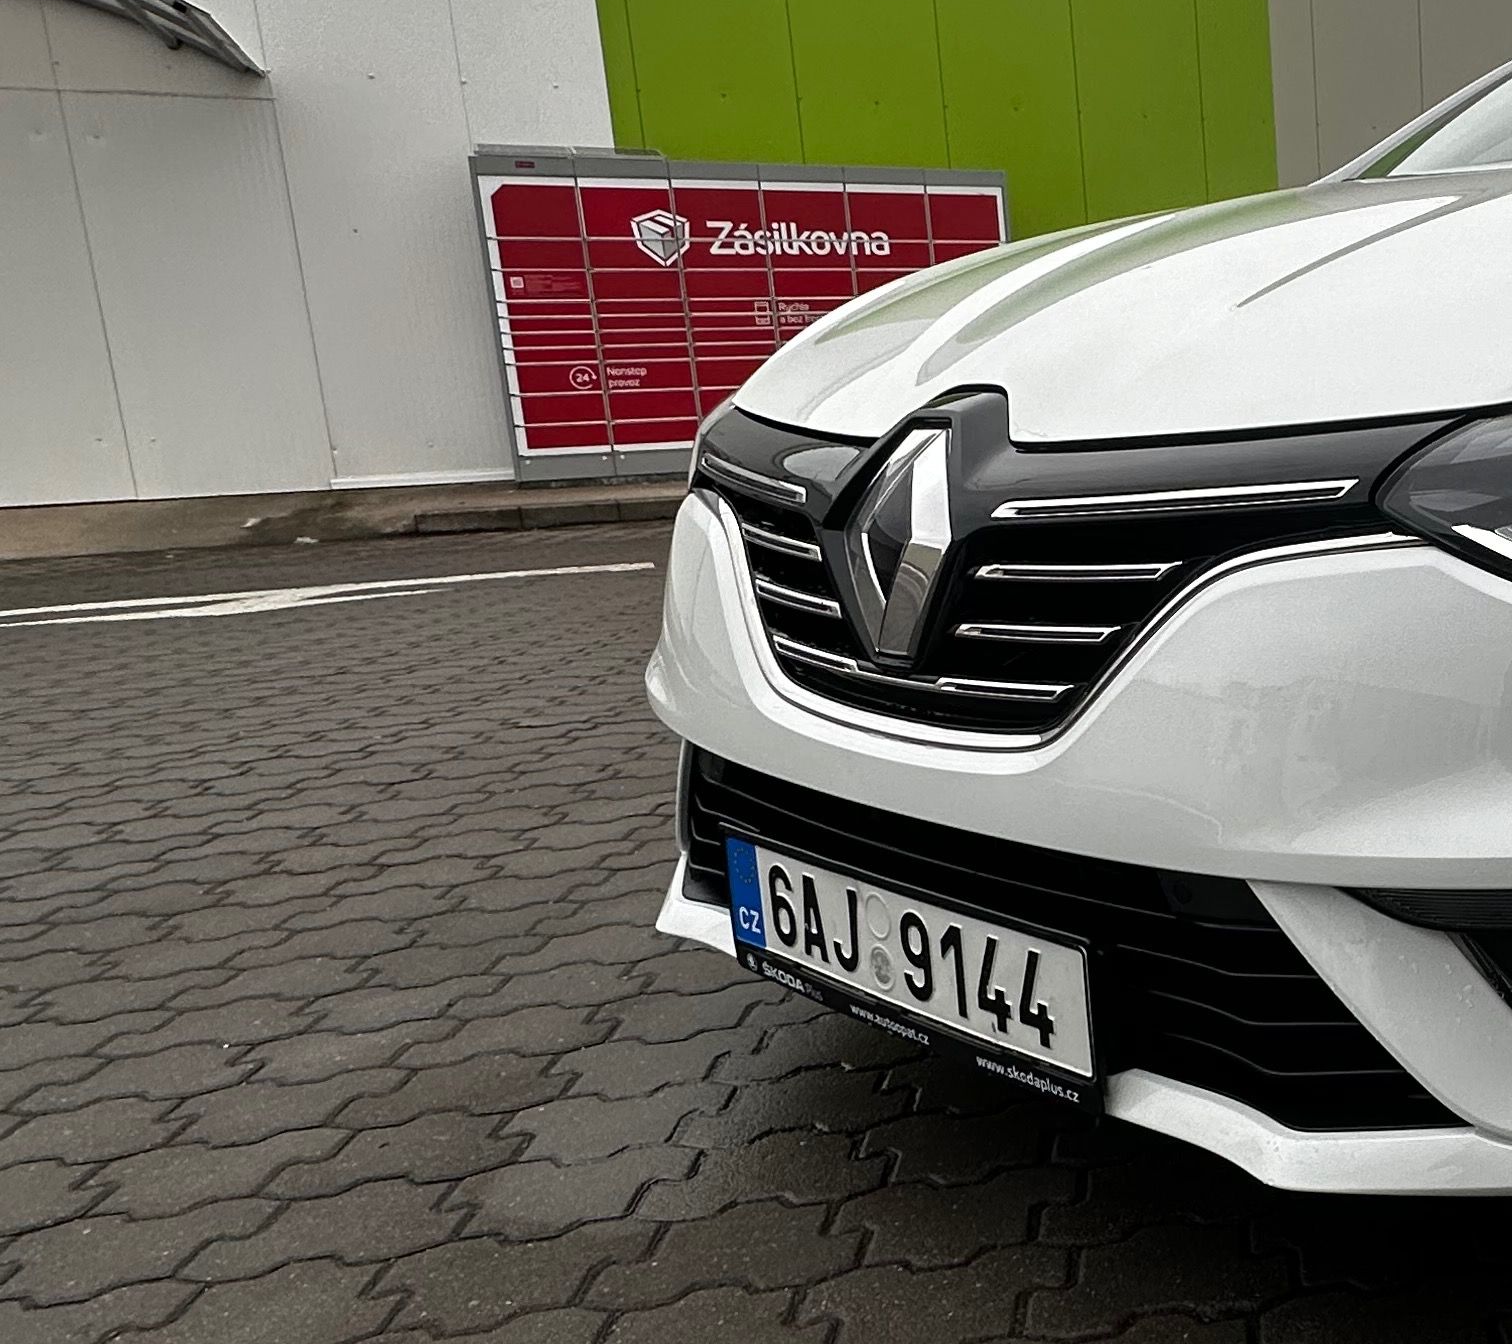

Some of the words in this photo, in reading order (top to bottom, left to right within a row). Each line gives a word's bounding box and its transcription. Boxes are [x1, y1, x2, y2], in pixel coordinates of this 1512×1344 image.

[706, 220, 891, 256] Zásilkovna
[739, 906, 761, 934] CZ
[768, 864, 860, 972] 6AJ
[900, 911, 1055, 1049] 9144
[975, 1056, 1080, 1104] www.skodaplus.cz
